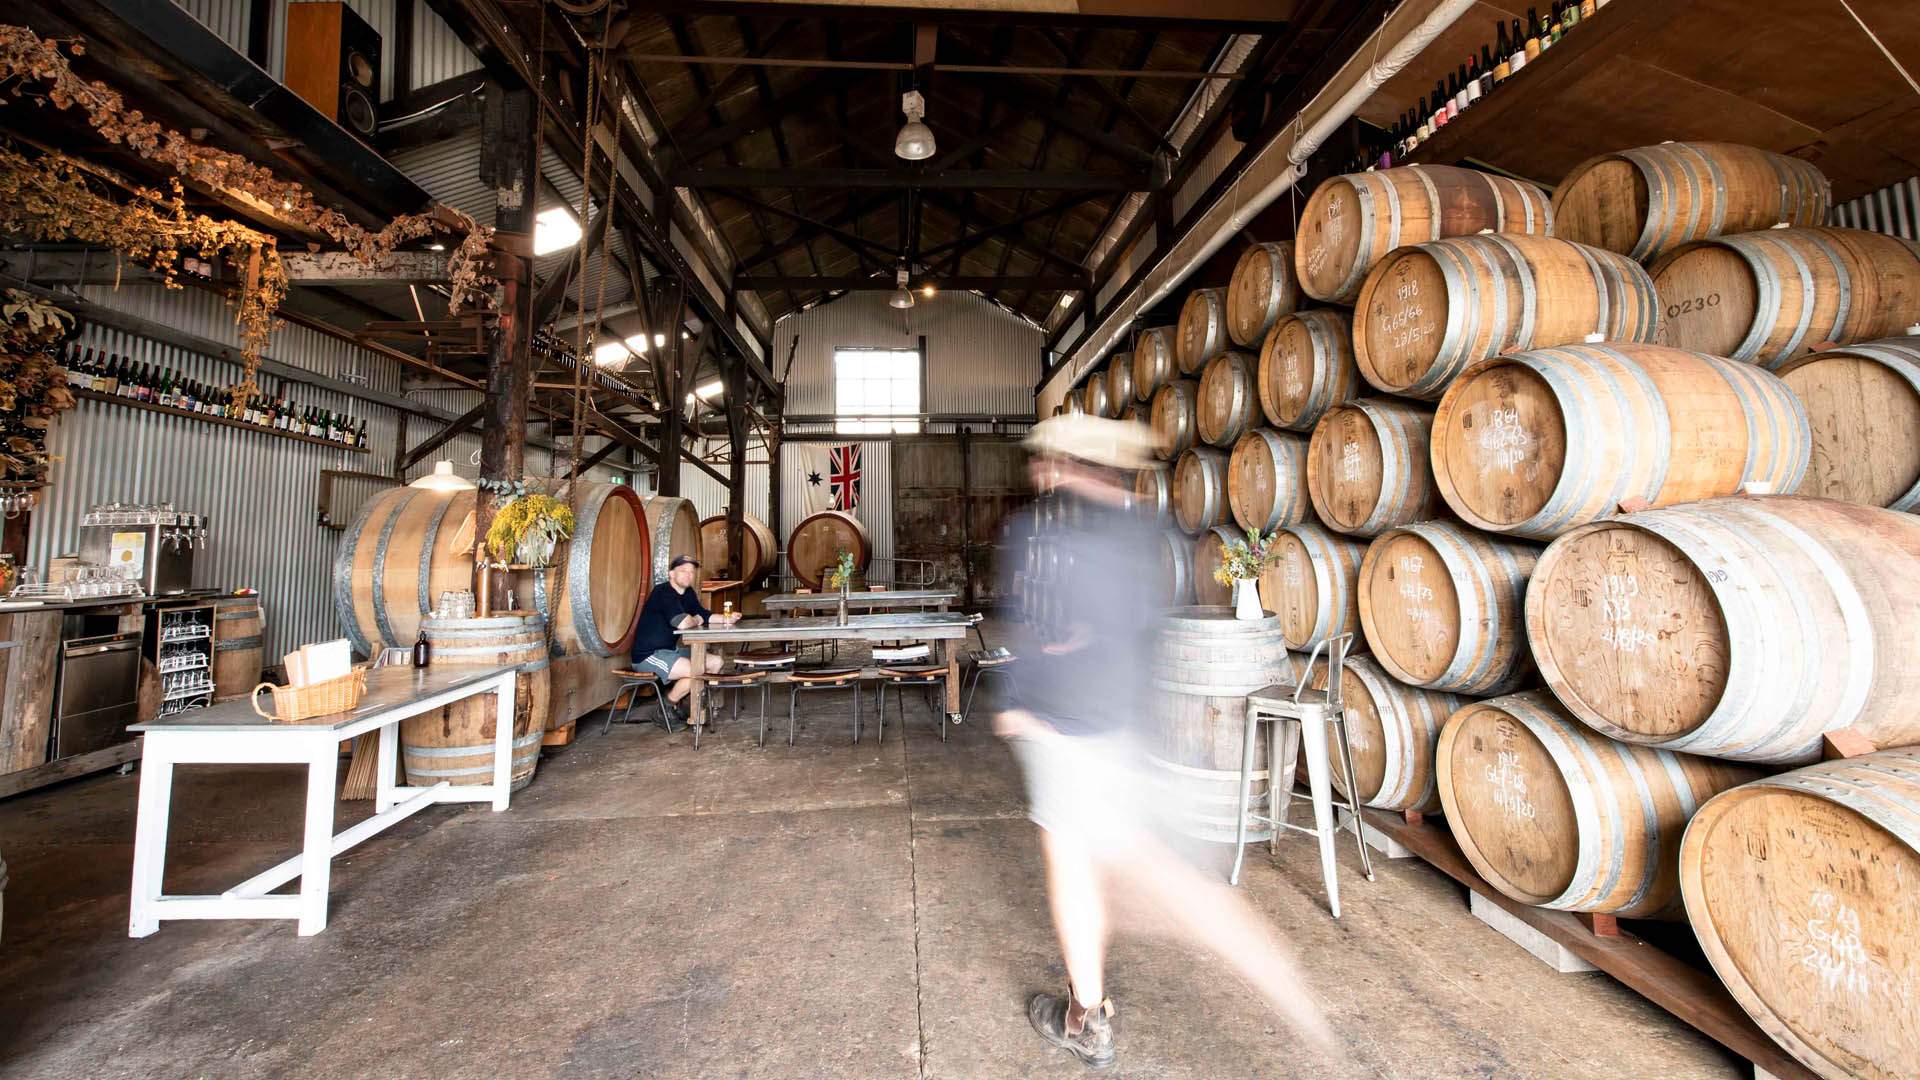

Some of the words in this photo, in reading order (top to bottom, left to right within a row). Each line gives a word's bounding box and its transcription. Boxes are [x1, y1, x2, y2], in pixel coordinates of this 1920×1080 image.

[1398, 279, 1419, 300] 1918
[1667, 293, 1721, 319] 0230
[1603, 574, 1639, 599] 1919
